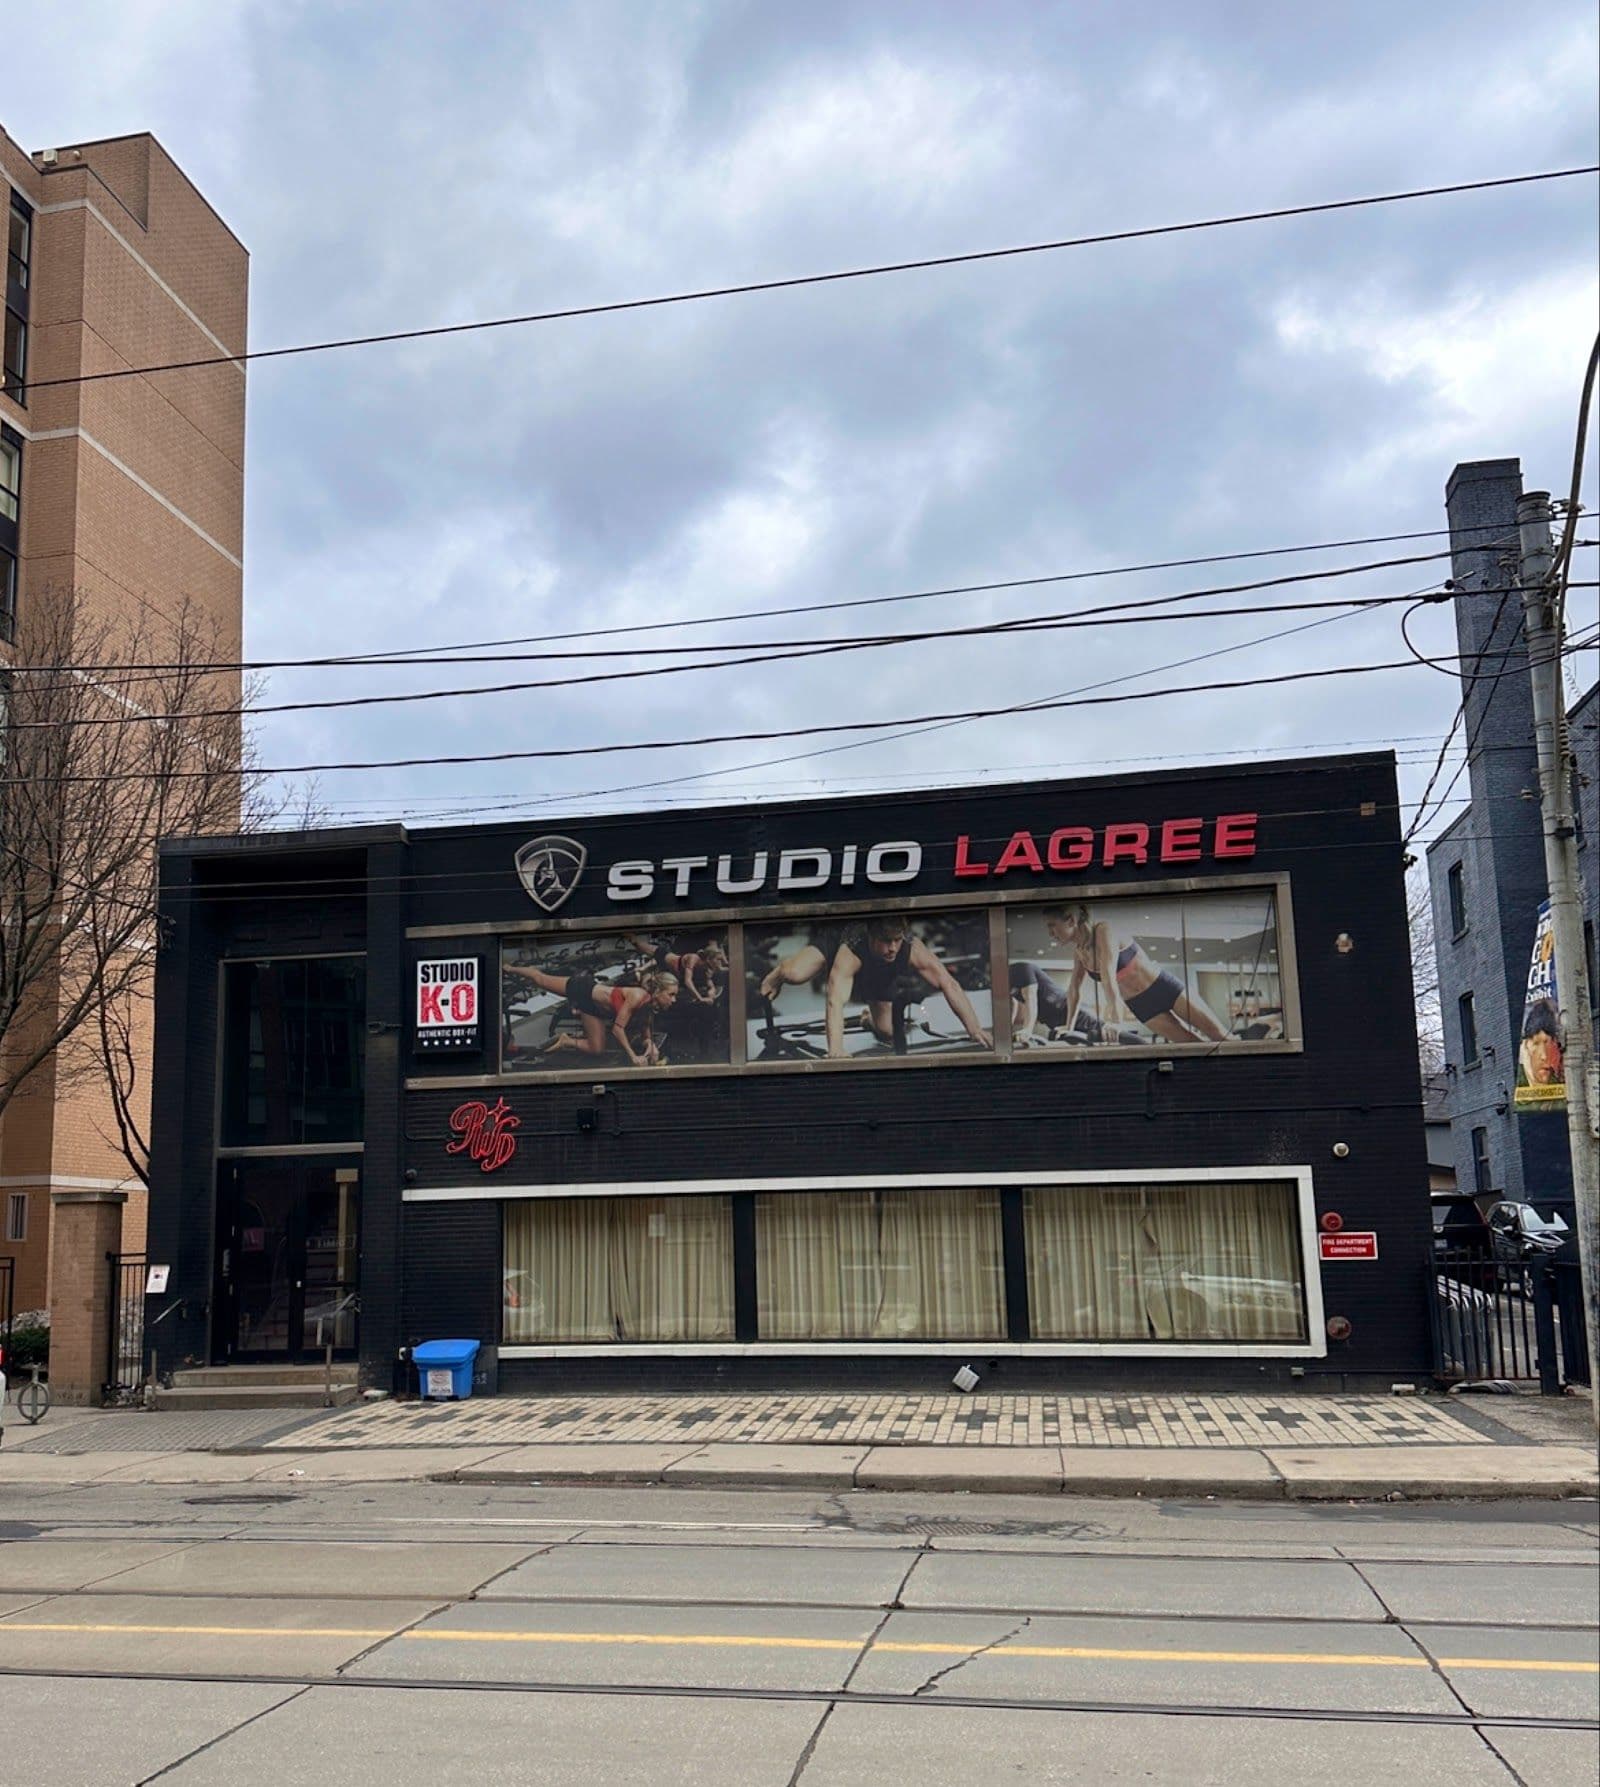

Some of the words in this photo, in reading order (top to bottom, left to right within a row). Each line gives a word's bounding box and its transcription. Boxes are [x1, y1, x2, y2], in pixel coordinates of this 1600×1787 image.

[606, 840, 922, 901] STUDIO
[954, 813, 1258, 877] LAGREE
[421, 962, 474, 983] STUDIO
[420, 984, 475, 1023] K-O
[417, 1029, 451, 1038] AUTHENTIC
[1336, 1238, 1373, 1246] DEPARTMENT
